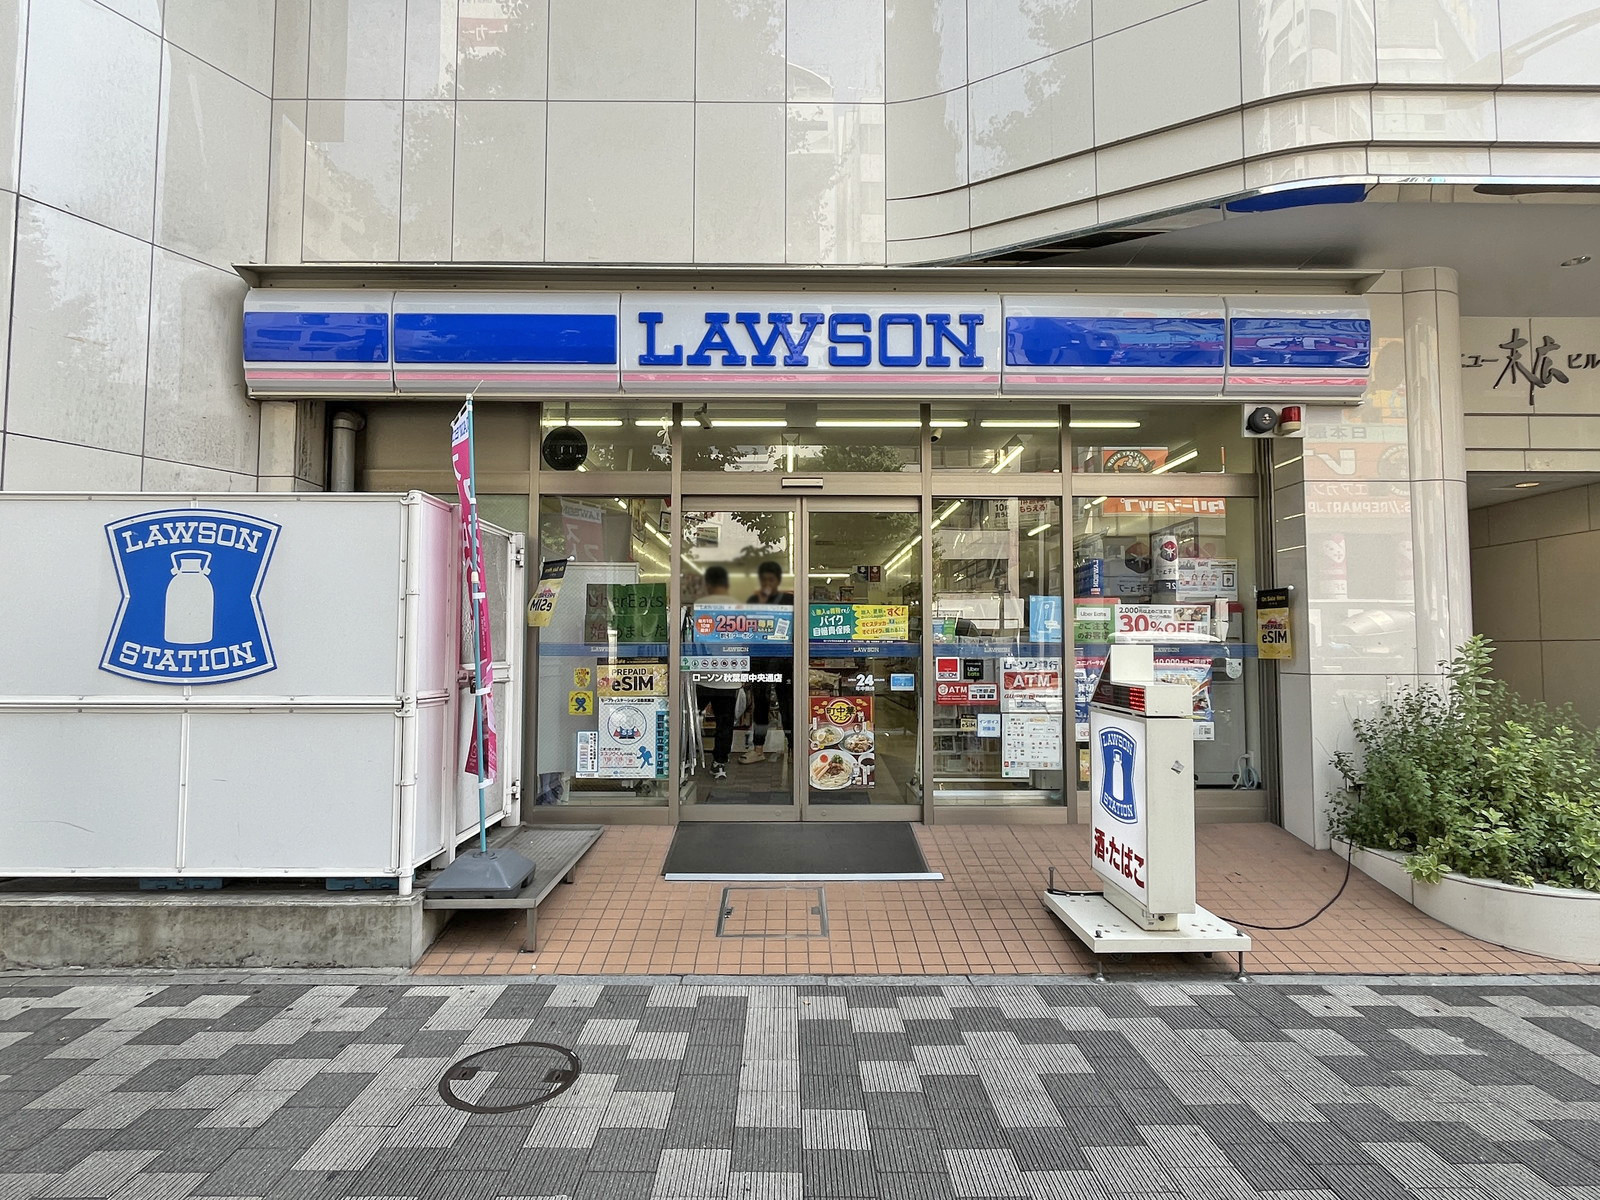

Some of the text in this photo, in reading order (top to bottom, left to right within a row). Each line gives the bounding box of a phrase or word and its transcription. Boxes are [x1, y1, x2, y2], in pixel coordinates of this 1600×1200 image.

[638, 312, 984, 367] LAWSON
[121, 521, 263, 553] LAWSON
[819, 614, 844, 626] バイク
[1261, 630, 1287, 643] eSIM
[119, 641, 257, 672] STATION
[612, 676, 654, 691] eSIM
[856, 673, 875, 686] 24
[1012, 674, 1051, 687] ATM
[1101, 732, 1134, 756] LAWSON
[1102, 791, 1135, 818] STATION
[1094, 826, 1145, 889] 酒・たばこ
